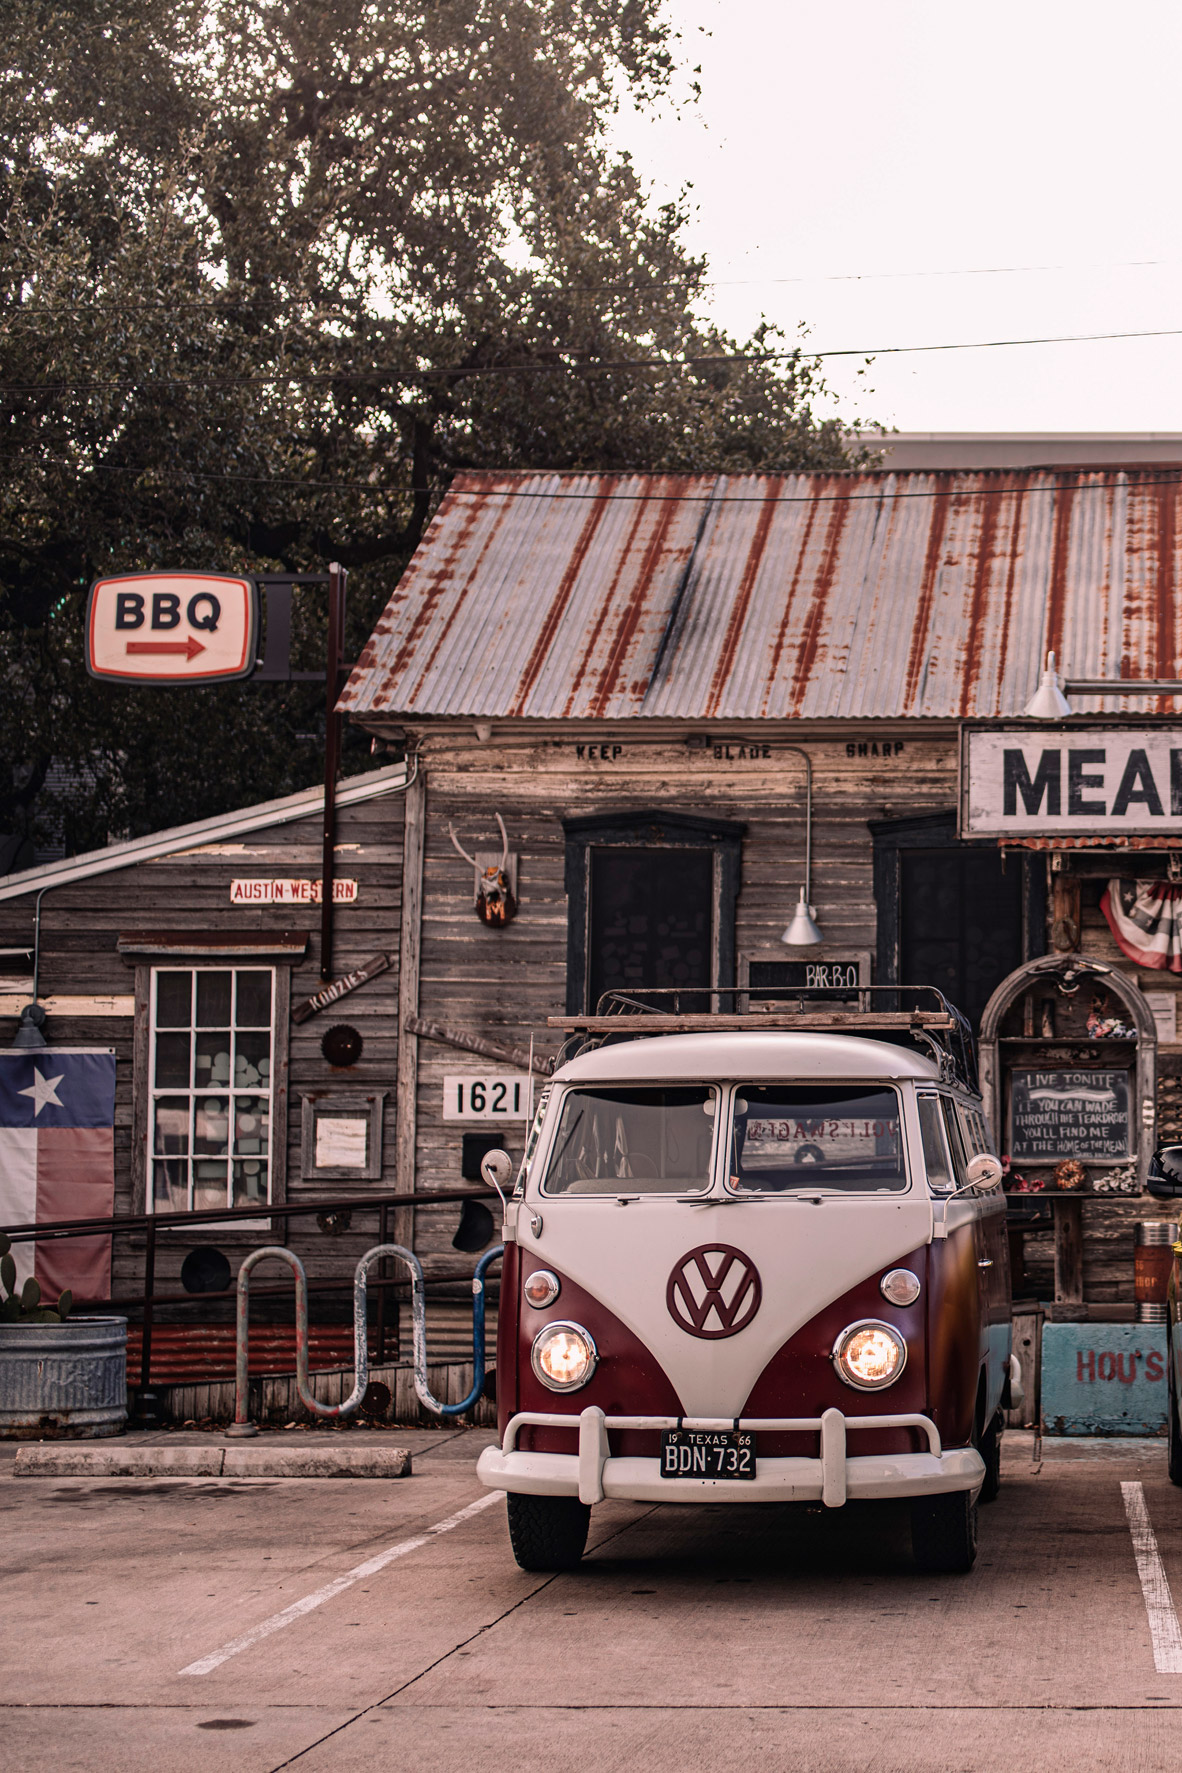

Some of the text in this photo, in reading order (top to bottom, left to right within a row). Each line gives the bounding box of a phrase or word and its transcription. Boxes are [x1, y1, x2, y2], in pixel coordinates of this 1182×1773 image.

[115, 592, 222, 633] BBQ
[576, 744, 624, 761] KEEP
[713, 744, 772, 760] BLADE
[845, 741, 905, 758] SHARP
[234, 882, 355, 899] AUSTIN-WESRN
[308, 969, 369, 1011] KOOZIES
[1026, 1074, 1116, 1089] LIVE TONITE
[457, 1082, 521, 1114] 1621
[1038, 1100, 1060, 1112] YOU
[1060, 1100, 1083, 1112] CAN
[1085, 1100, 1119, 1112] WADE
[1059, 1127, 1088, 1139] FIND
[1089, 1127, 1111, 1139] ME
[1013, 1141, 1030, 1153] AT
[1031, 1141, 1055, 1153] THE
[1056, 1140, 1081, 1153] HOME
[668, 1433, 751, 1446] 19 TEXAS 66
